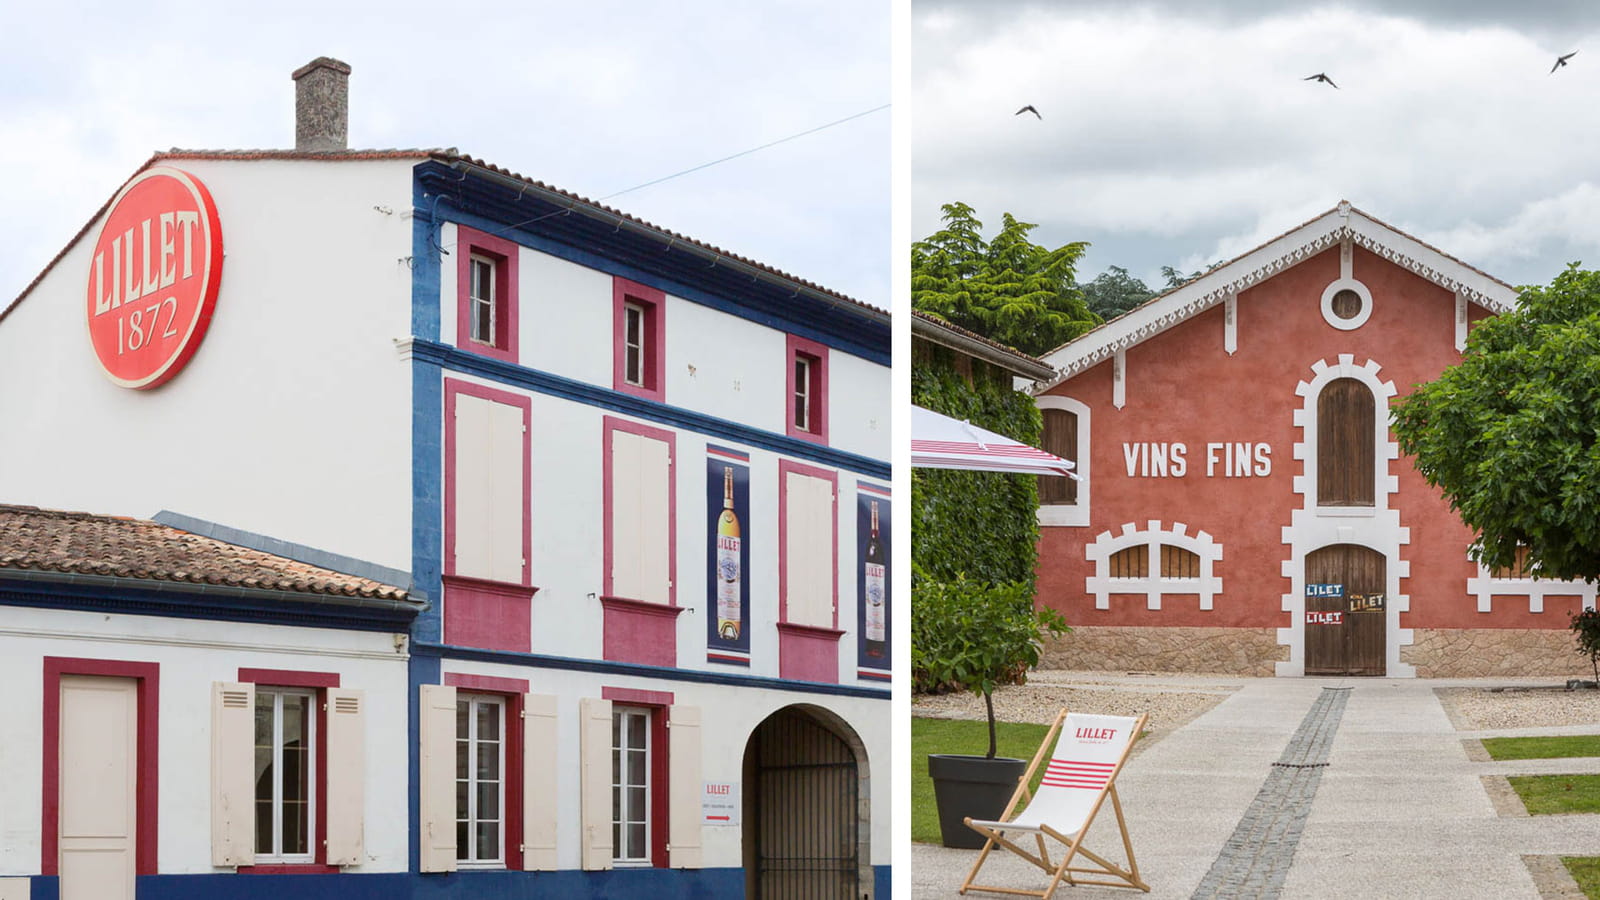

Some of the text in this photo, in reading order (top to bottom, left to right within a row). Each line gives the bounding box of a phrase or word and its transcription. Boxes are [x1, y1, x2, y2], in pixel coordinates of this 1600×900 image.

[95, 211, 199, 317] LILLET
[118, 296, 178, 356] 1872
[1123, 442, 1271, 477] VINS FINS
[1075, 727, 1118, 740] LILLET
[706, 784, 731, 795] LILLET
